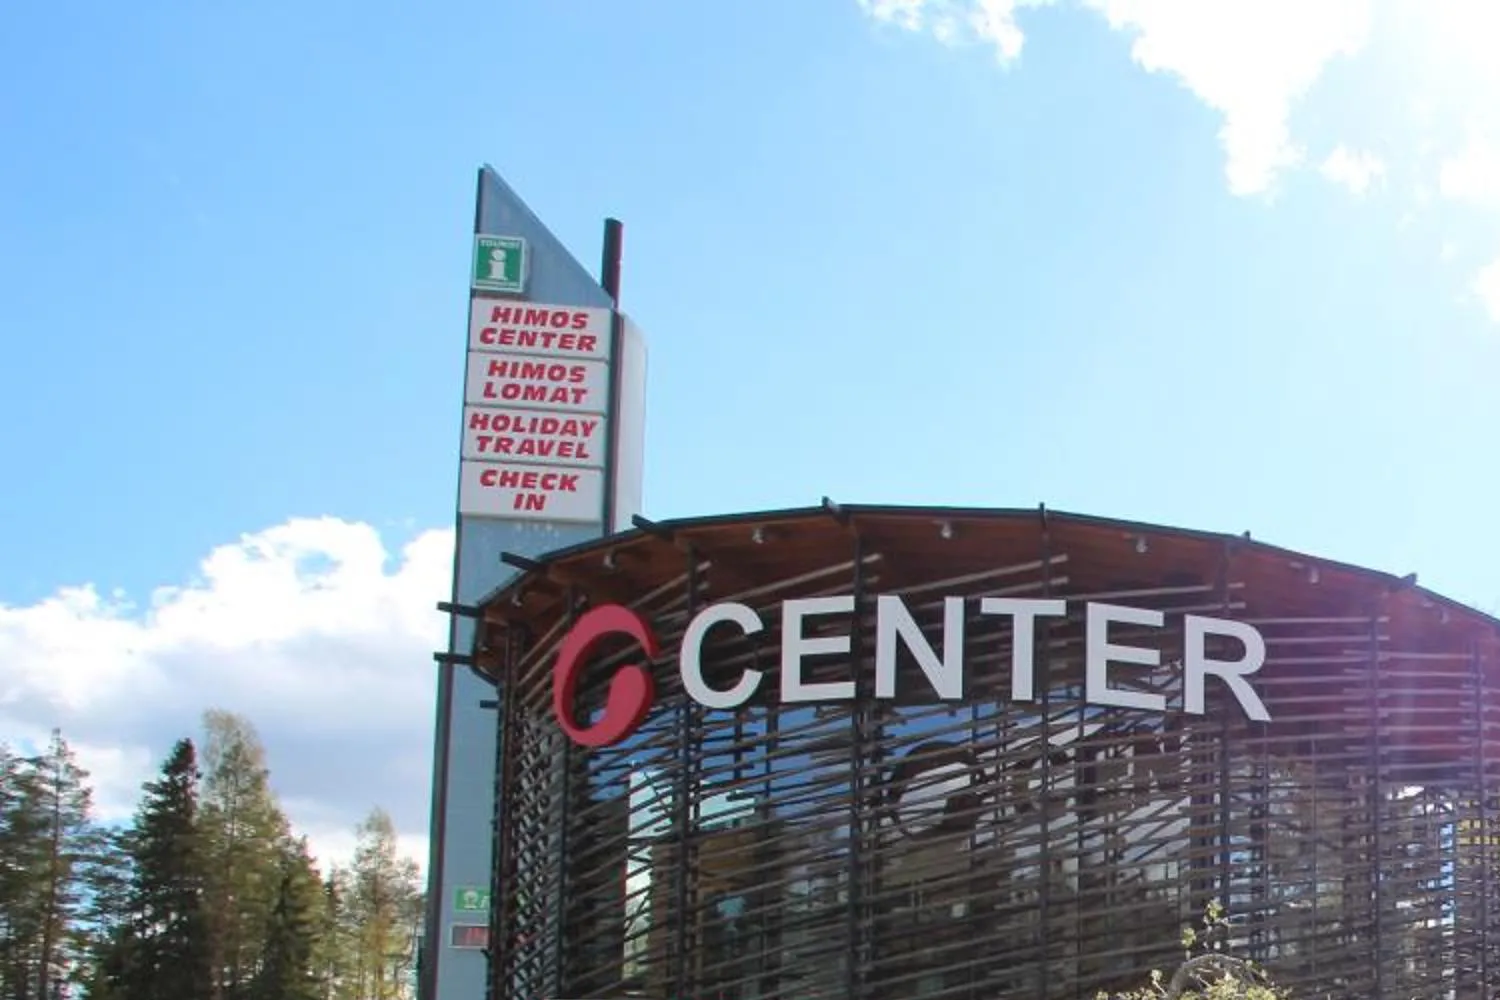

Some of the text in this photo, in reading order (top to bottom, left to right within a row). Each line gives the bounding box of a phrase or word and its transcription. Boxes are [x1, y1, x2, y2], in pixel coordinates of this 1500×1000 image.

[491, 305, 590, 330] HIMOS
[479, 327, 597, 353] CENTER
[487, 359, 586, 383] HIMOS
[482, 382, 587, 406] LOMAT
[469, 413, 597, 438] HOLIDAY
[476, 436, 590, 460] TRAVEL
[479, 469, 580, 492] CHECK
[513, 493, 546, 511] IN
[680, 595, 1271, 722] CENTER
